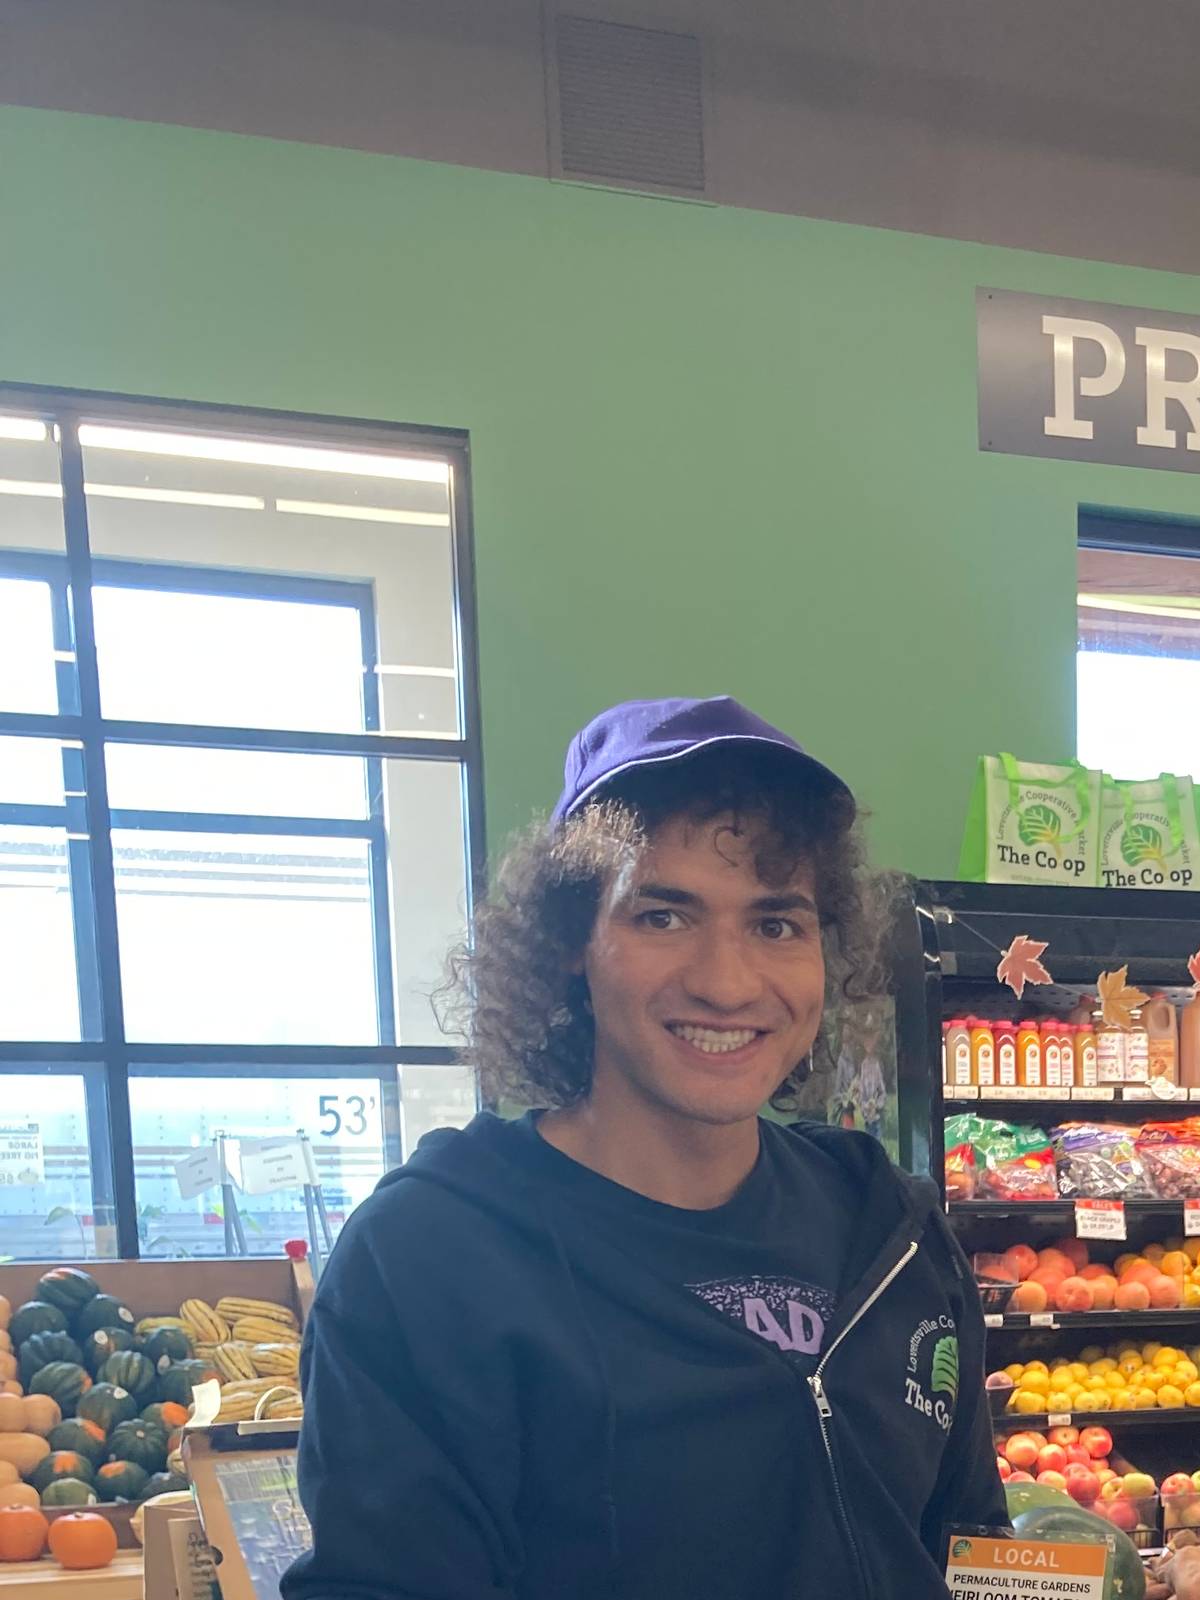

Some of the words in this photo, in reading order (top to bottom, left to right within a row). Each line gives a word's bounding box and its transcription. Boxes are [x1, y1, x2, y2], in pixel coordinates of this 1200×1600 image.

[997, 844, 1030, 865] The
[1035, 851, 1057, 869] Co
[1063, 858, 1086, 877] op
[1102, 869, 1136, 887] The
[1140, 868, 1164, 885] Co
[1170, 869, 1192, 886] op
[906, 1319, 938, 1373] Lovettsville
[905, 1377, 933, 1417] The
[993, 1547, 1060, 1568] LOCAL
[953, 1574, 1039, 1590] PERMACULTURE
[1040, 1580, 1091, 1593] GARDENS
